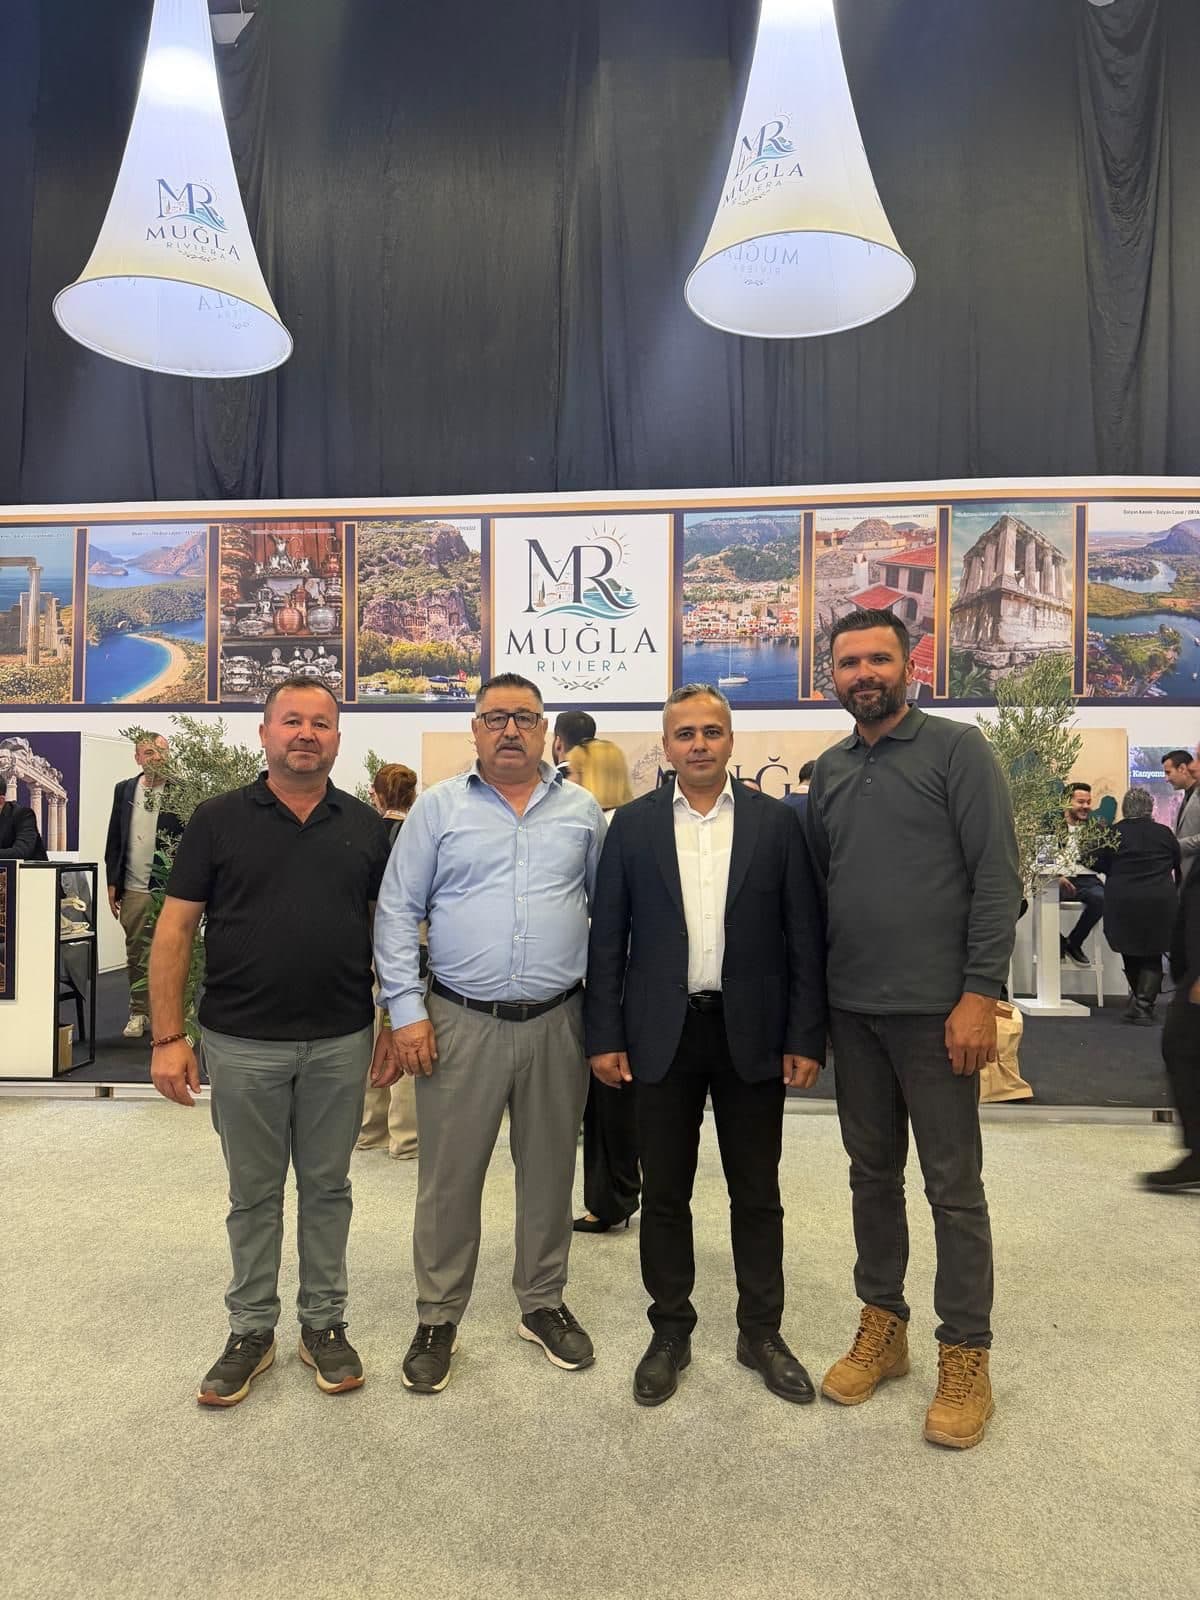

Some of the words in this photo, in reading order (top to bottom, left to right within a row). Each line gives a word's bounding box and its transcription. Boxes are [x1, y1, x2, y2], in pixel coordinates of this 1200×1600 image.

[722, 162, 803, 208] MUĞLA
[146, 223, 240, 261] MUĞLA
[166, 241, 225, 260] RIVIERA
[522, 538, 640, 613] MR
[505, 622, 659, 655] MUĞLA
[537, 660, 628, 672] RIVIERA
